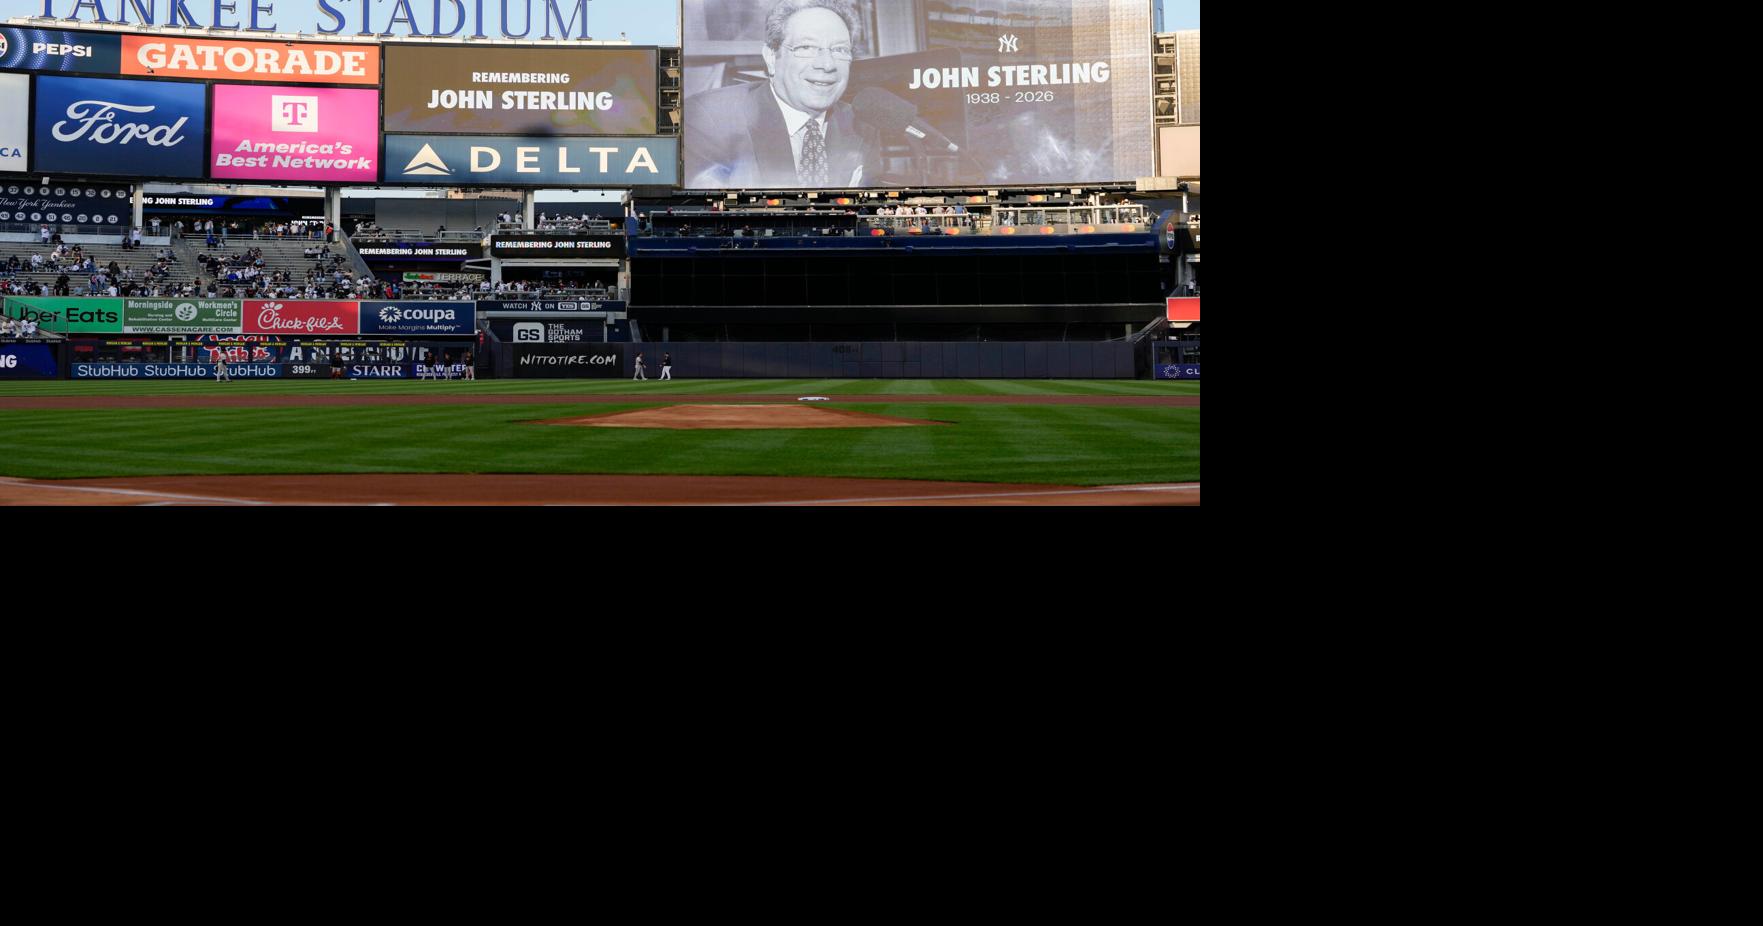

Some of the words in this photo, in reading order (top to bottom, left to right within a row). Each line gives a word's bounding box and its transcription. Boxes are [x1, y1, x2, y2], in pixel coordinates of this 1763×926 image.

[316, 0, 592, 41] STADIUM
[33, 42, 92, 58] PEPSI
[137, 42, 366, 76] GATORADE
[472, 72, 570, 84] REMEMBERING
[909, 66, 979, 89] JOHN
[987, 62, 1110, 88] STERLING
[427, 90, 493, 109] JOHN
[502, 91, 614, 111] STERLING
[966, 92, 1000, 104] 1938
[1015, 91, 1054, 103] 2026
[52, 100, 190, 147] Ford
[234, 140, 353, 155] America's
[216, 153, 269, 168] Best
[272, 155, 372, 170] Network
[470, 146, 659, 173] DELTA
[18, 198, 38, 209] York
[40, 198, 76, 210] Yankees
[496, 241, 552, 249] REMEMBERING
[553, 241, 575, 249] JOHN
[576, 241, 611, 249] STERLING
[359, 248, 412, 256] REMEMBERING
[435, 249, 467, 257] STERLING
[128, 300, 173, 310] Morningside
[198, 301, 238, 309] Workmen's
[66, 307, 118, 323] Eats
[215, 309, 238, 317] Circle
[257, 307, 343, 330] Chick-fil-A
[403, 308, 455, 324] coupa
[398, 324, 425, 332] Margins
[517, 329, 540, 341] GS
[520, 353, 616, 366] NITTOTIRE.COM
[77, 364, 139, 377] StubHub
[144, 364, 207, 377] StubHub
[351, 366, 401, 377] STARR
